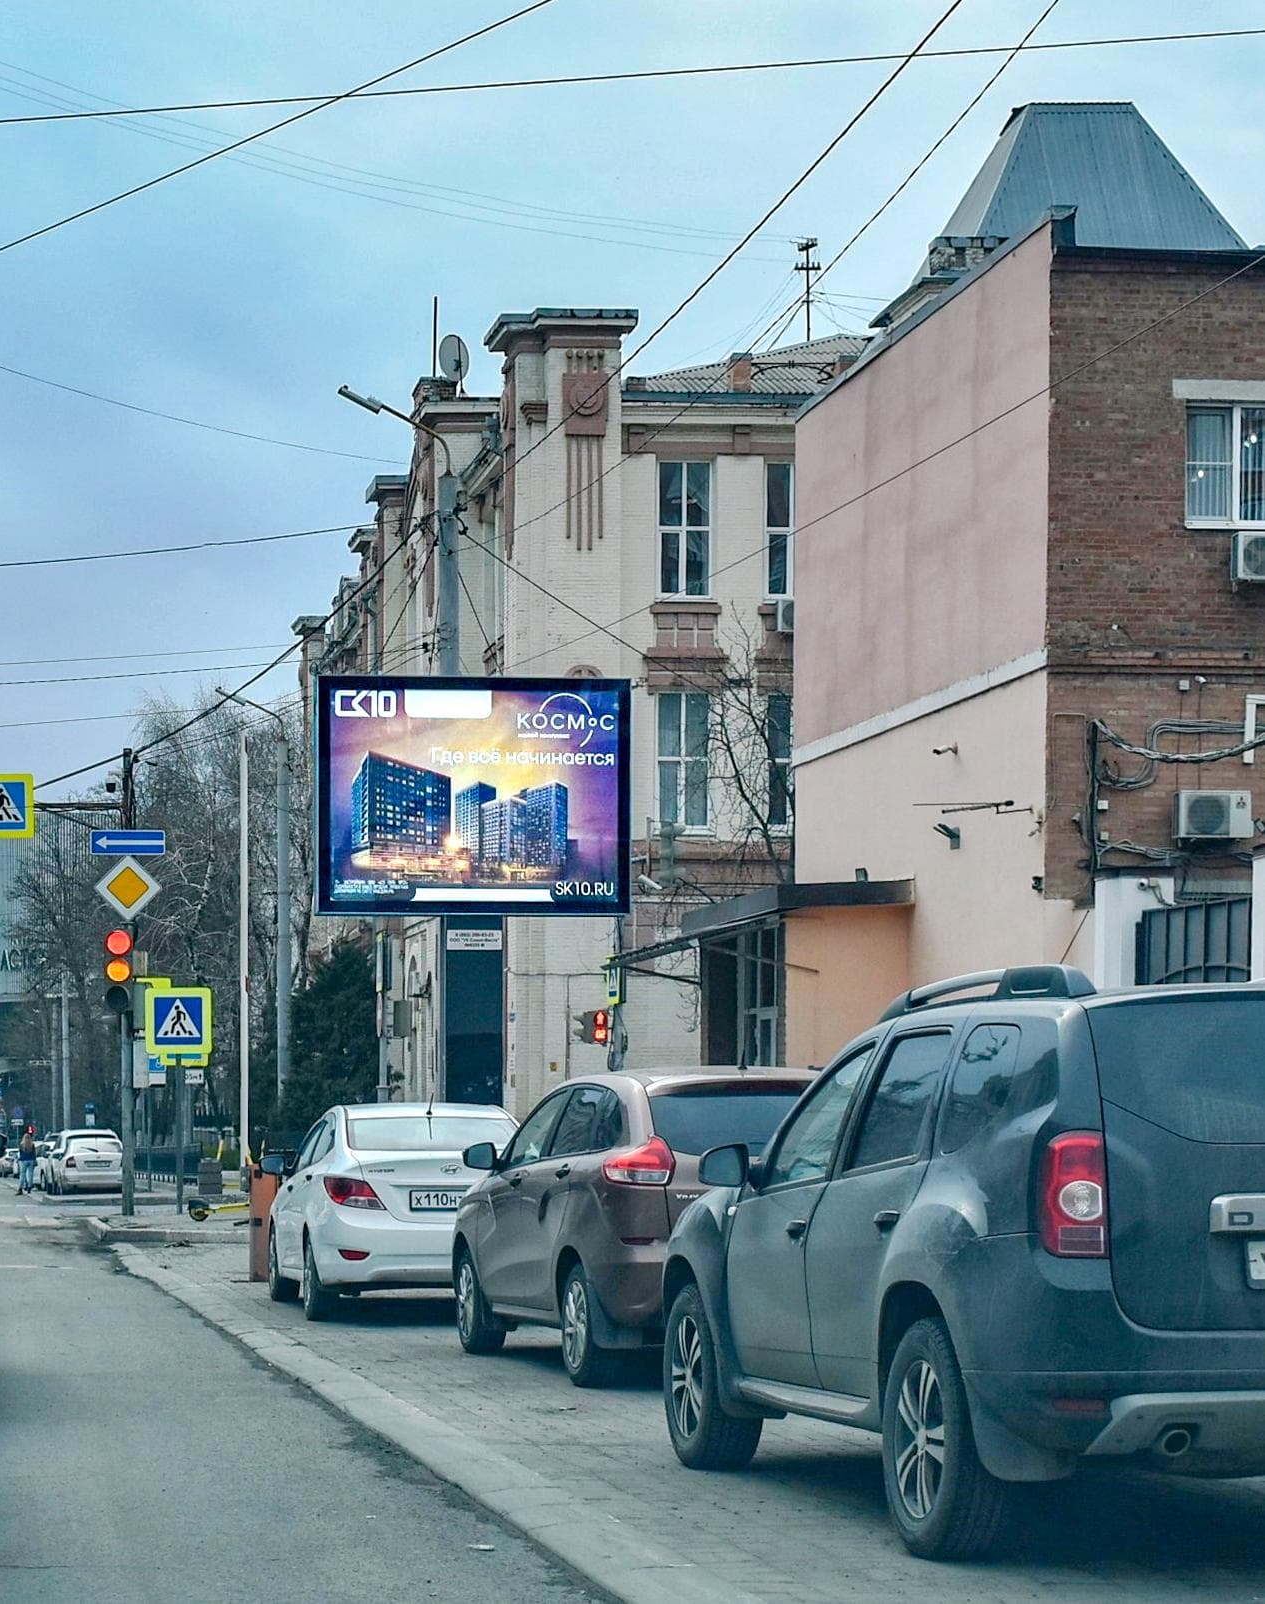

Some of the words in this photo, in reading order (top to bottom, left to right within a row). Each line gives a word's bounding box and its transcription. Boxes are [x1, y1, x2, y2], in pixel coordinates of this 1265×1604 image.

[430, 746, 464, 766] Где
[468, 747, 501, 764] всё
[505, 752, 615, 766] начинается
[555, 881, 614, 896] SK10.RU
